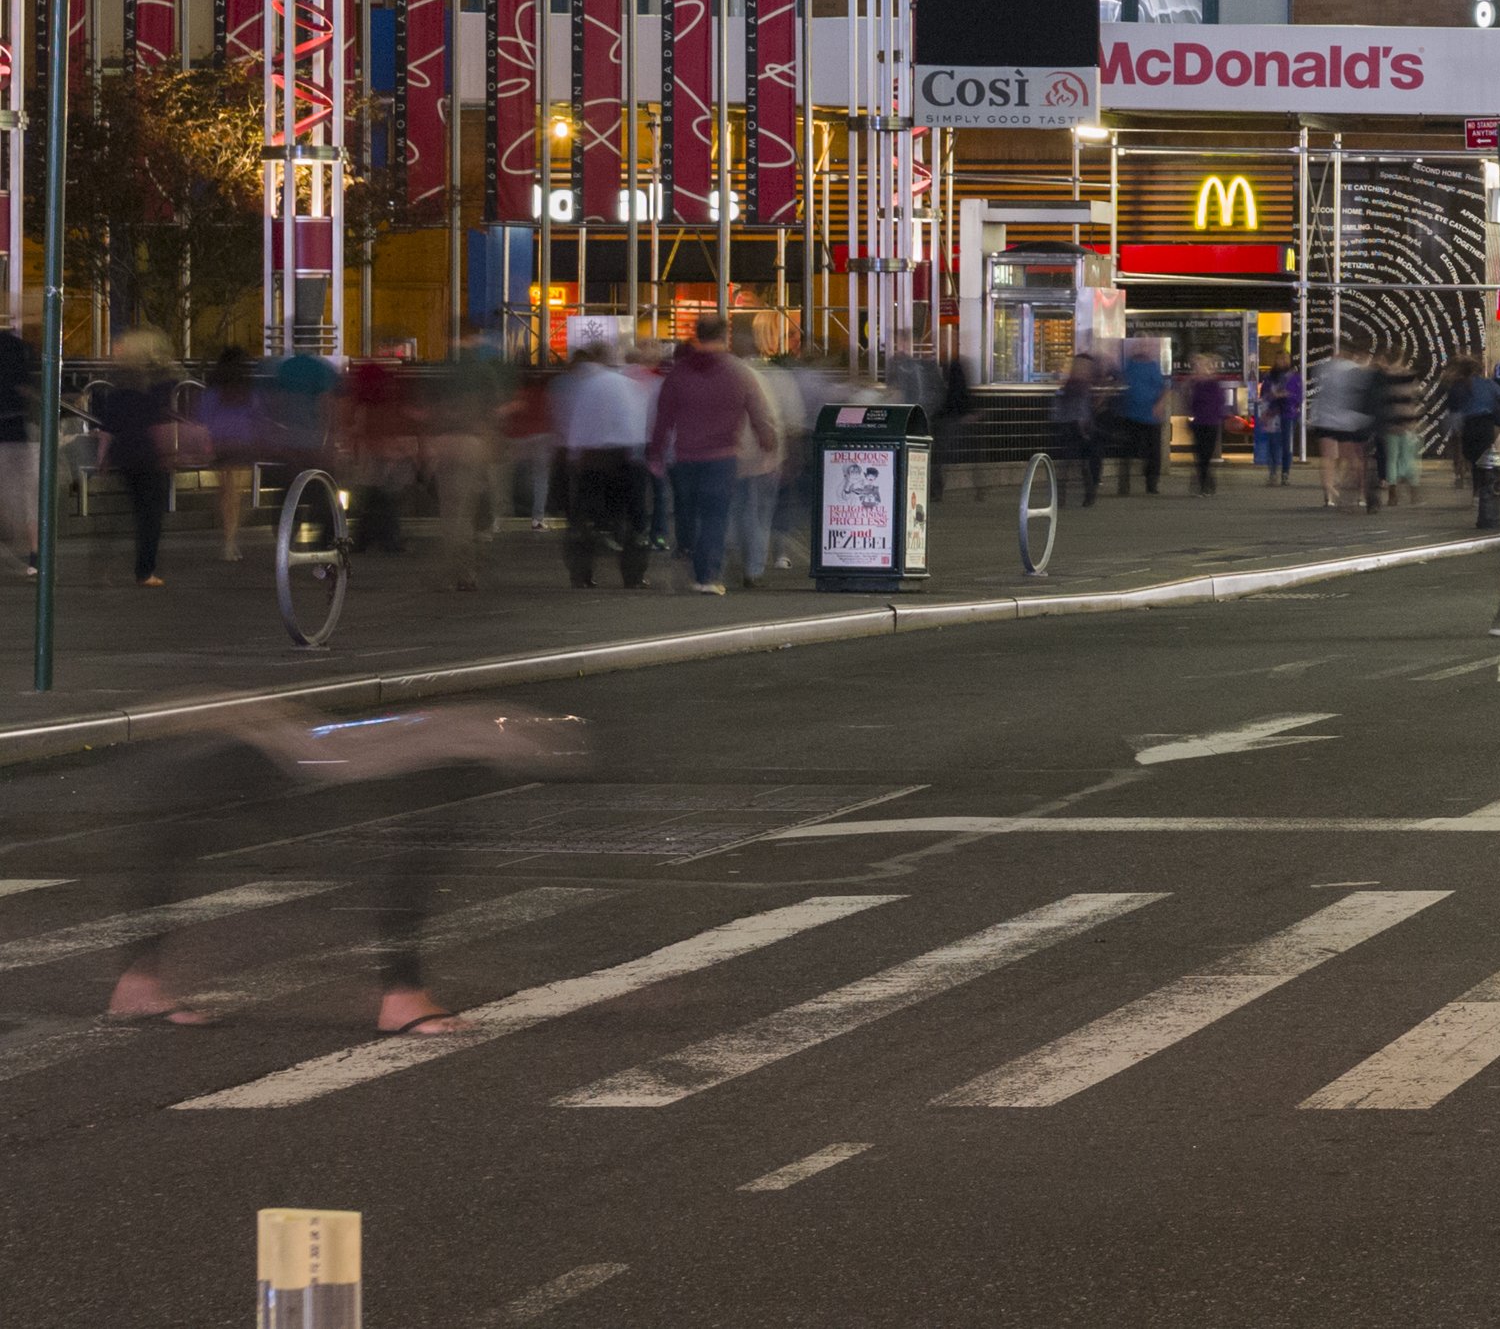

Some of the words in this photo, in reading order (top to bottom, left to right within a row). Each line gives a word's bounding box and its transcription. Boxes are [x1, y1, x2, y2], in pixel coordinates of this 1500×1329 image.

[1100, 43, 1424, 90] McDonald's
[922, 69, 1029, 107] Così
[926, 114, 980, 124] SIMPLY
[987, 115, 1031, 124] GOOD
[748, 74, 757, 211] PARAMOUNT
